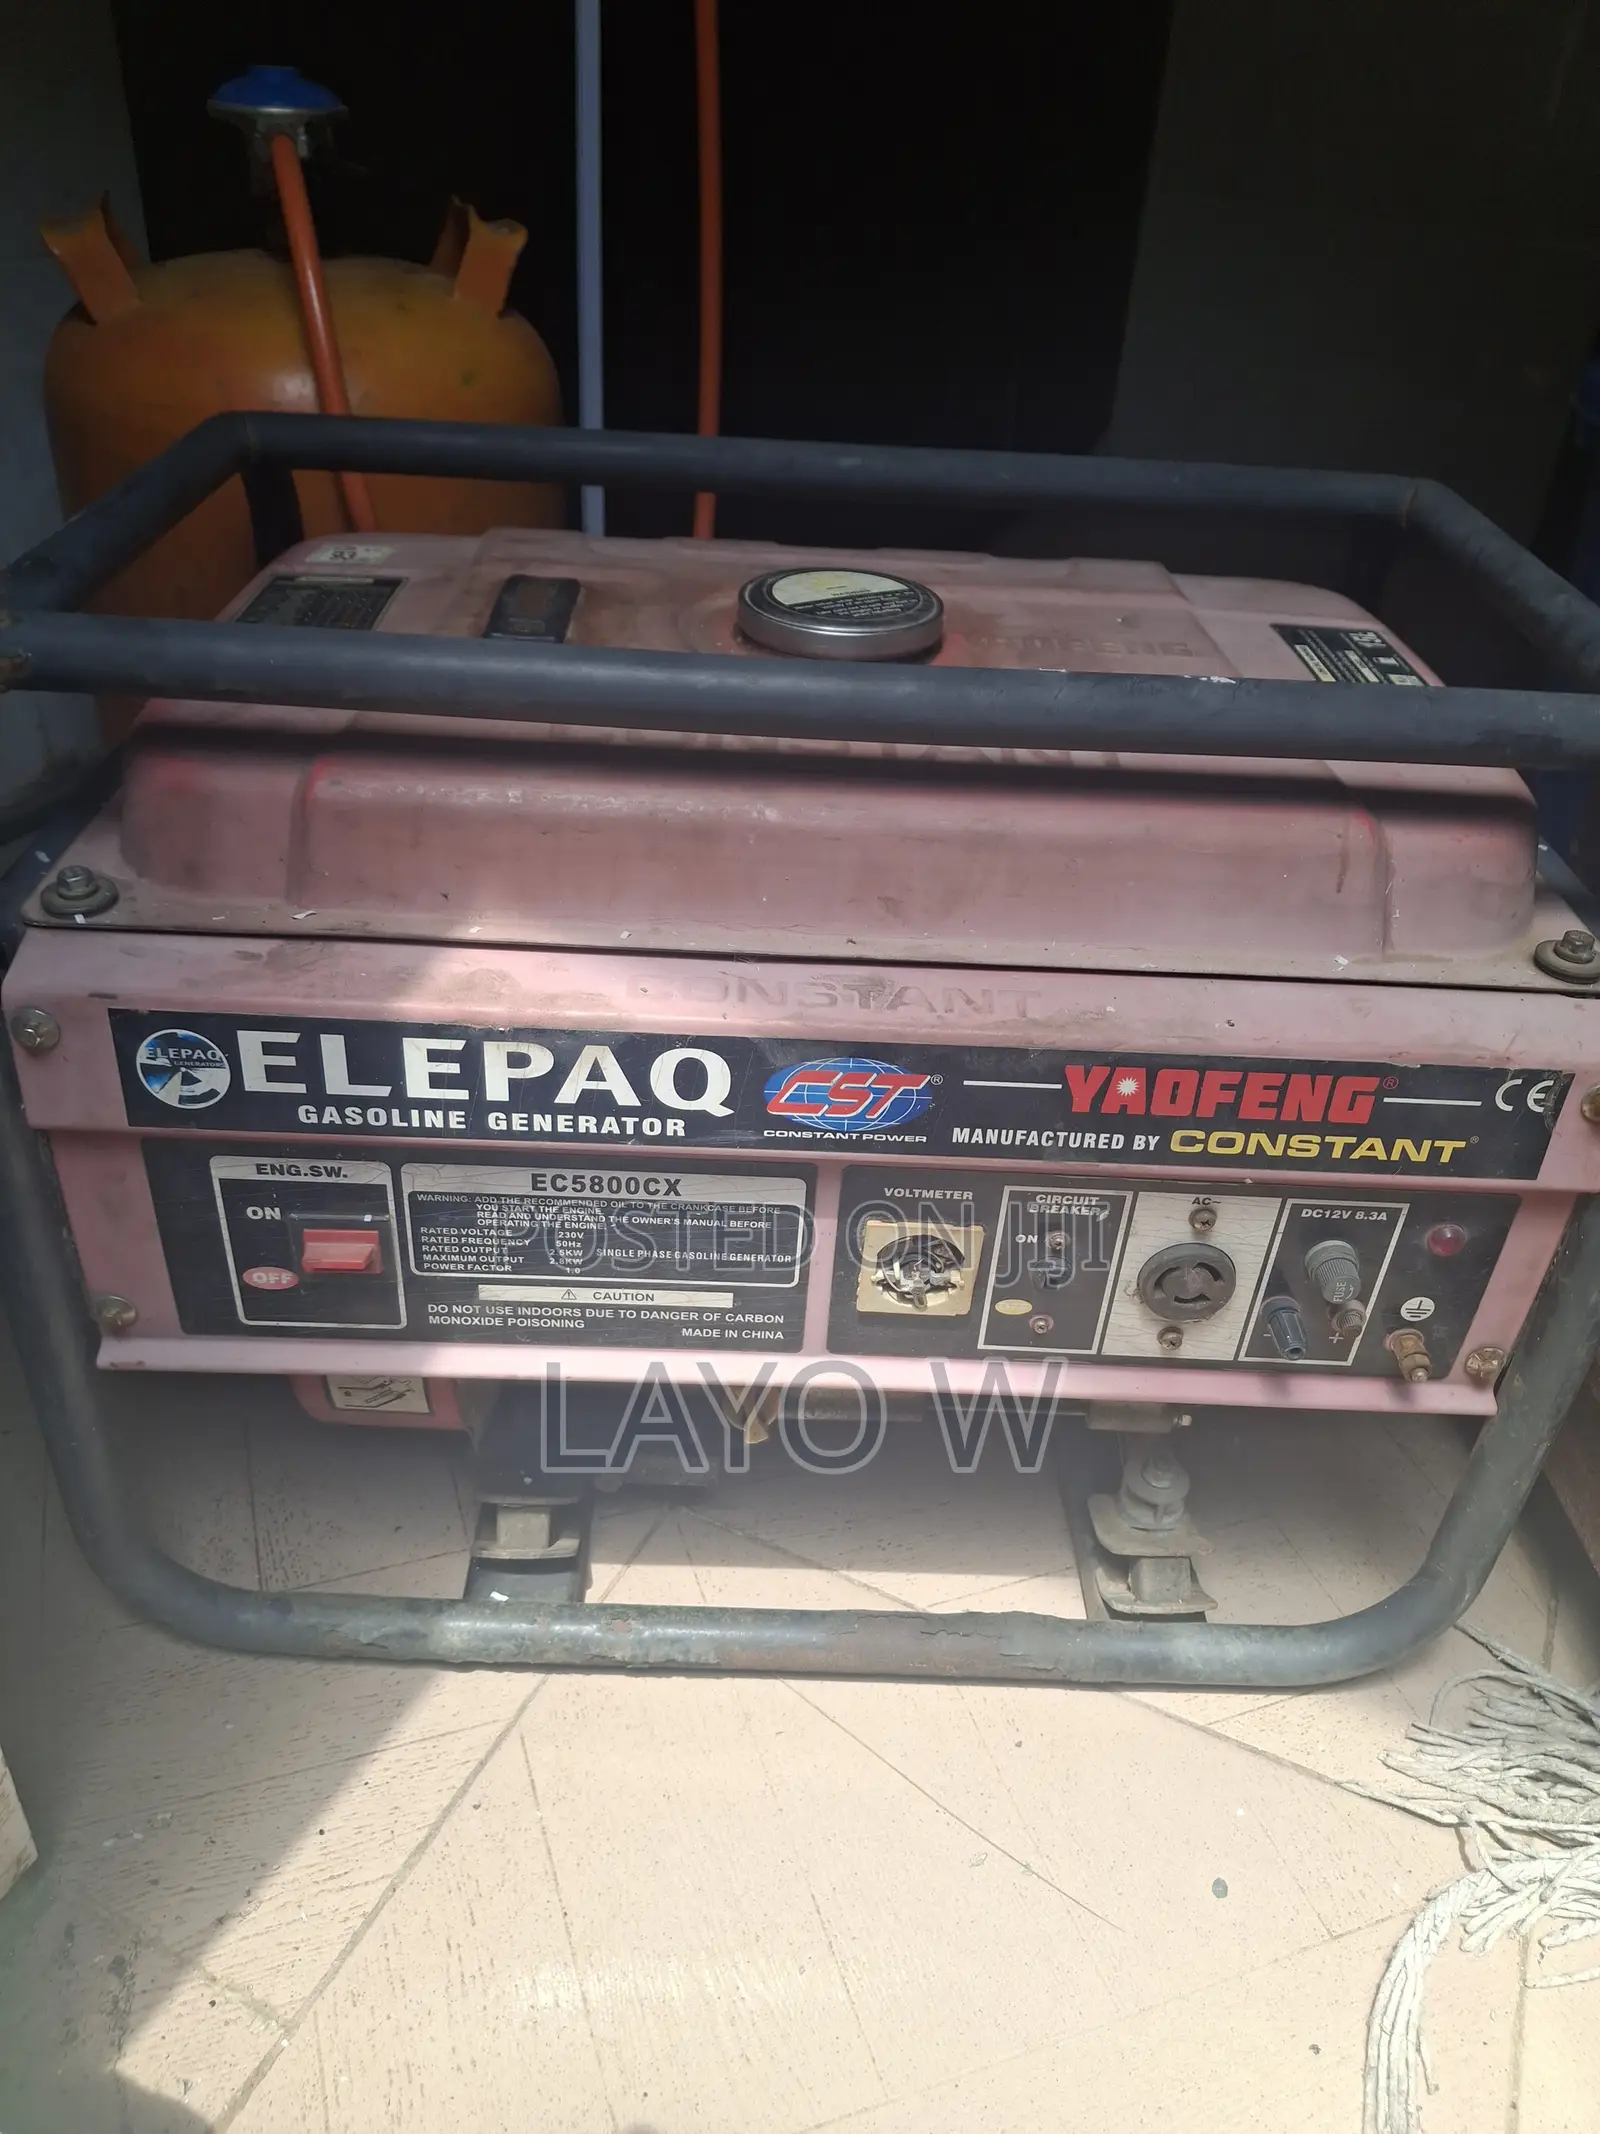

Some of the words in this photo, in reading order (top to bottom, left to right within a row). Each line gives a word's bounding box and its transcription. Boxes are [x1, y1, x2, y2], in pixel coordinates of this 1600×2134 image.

[146, 1047, 222, 1061] ELEPAQ
[236, 1029, 734, 1118] ELEPAQ
[766, 1070, 931, 1119] CST
[1065, 1065, 1382, 1125] YAOFENG
[1495, 1078, 1556, 1113] CE
[297, 1104, 466, 1129] GASOLINE
[487, 1112, 686, 1137] GENERATOR
[763, 1129, 859, 1142] CONSTANT
[862, 1133, 927, 1143] POWER
[952, 1127, 1125, 1149] MANUFACTURED
[1133, 1134, 1160, 1151] BY
[1170, 1130, 1467, 1163] CONSTANT
[255, 1163, 348, 1178] ENG.SW.
[531, 1173, 682, 1197] EC5800CX
[884, 1187, 973, 1200] VOLTMETER
[1035, 1194, 1100, 1205] CIRCUIT
[417, 1193, 472, 1203] WARNING:
[474, 1196, 497, 1204] ADD
[500, 1197, 520, 1205] THE
[524, 1198, 607, 1208] RECOMMENDED
[610, 1200, 628, 1208] OIL
[630, 1201, 645, 1209] TO
[647, 1202, 668, 1210] THE
[671, 1203, 736, 1213] CRANKCASE
[738, 1205, 781, 1215] BEFORE
[476, 1203, 499, 1211] YOU
[502, 1204, 535, 1213] START
[540, 1205, 559, 1214] THE
[1028, 1203, 1102, 1216] BREAKER
[246, 1206, 281, 1220] ON
[477, 1211, 507, 1219] READ
[509, 1212, 532, 1220] AND
[535, 1213, 606, 1223] UNDERSTAND
[609, 1215, 629, 1224] THE
[632, 1216, 681, 1226] OWNER'S
[683, 1218, 728, 1227] MANUAL
[730, 1219, 772, 1229] BEFORE
[1301, 1208, 1352, 1219] DC12V
[1354, 1211, 1387, 1221] 8.3A
[477, 1218, 539, 1228] OPERATING
[541, 1220, 562, 1229] THE
[420, 1226, 458, 1235] RATED
[460, 1228, 513, 1237] VOLTAGE
[558, 1231, 585, 1239] 230V
[1015, 1234, 1039, 1243] ON
[421, 1236, 459, 1244] RATED
[461, 1237, 532, 1246] FREQUENCY
[555, 1240, 582, 1248] 50Hz
[422, 1245, 460, 1253] RATED
[461, 1246, 508, 1254] OUTPUT
[549, 1248, 583, 1256] 2.5KW
[596, 1248, 635, 1258] SINGLE
[637, 1250, 672, 1259] PHASE
[674, 1251, 728, 1261] GASOLINE
[729, 1253, 792, 1263] GENERATOR
[423, 1254, 477, 1262] MAXIMUM
[479, 1255, 525, 1263] OUTPUT
[423, 1262, 465, 1270] POWER
[467, 1263, 512, 1272] FACTOR
[251, 1271, 294, 1285] OFF
[593, 1291, 655, 1302] CAUTION
[1333, 1281, 1347, 1302] FUSE
[427, 1304, 449, 1313] DO
[452, 1304, 481, 1314] NOT
[485, 1306, 514, 1315] USE
[517, 1306, 582, 1317] INDOORS
[585, 1308, 614, 1318] DUE
[618, 1309, 637, 1319] TO
[640, 1310, 700, 1321] DANGER
[703, 1312, 722, 1322] OF
[725, 1313, 784, 1324] CARBON
[428, 1315, 504, 1326] MONOXIDE
[507, 1318, 585, 1328] POISONING
[681, 1328, 721, 1338] MADE
[725, 1329, 738, 1338] IN
[742, 1329, 784, 1340] CHINA
